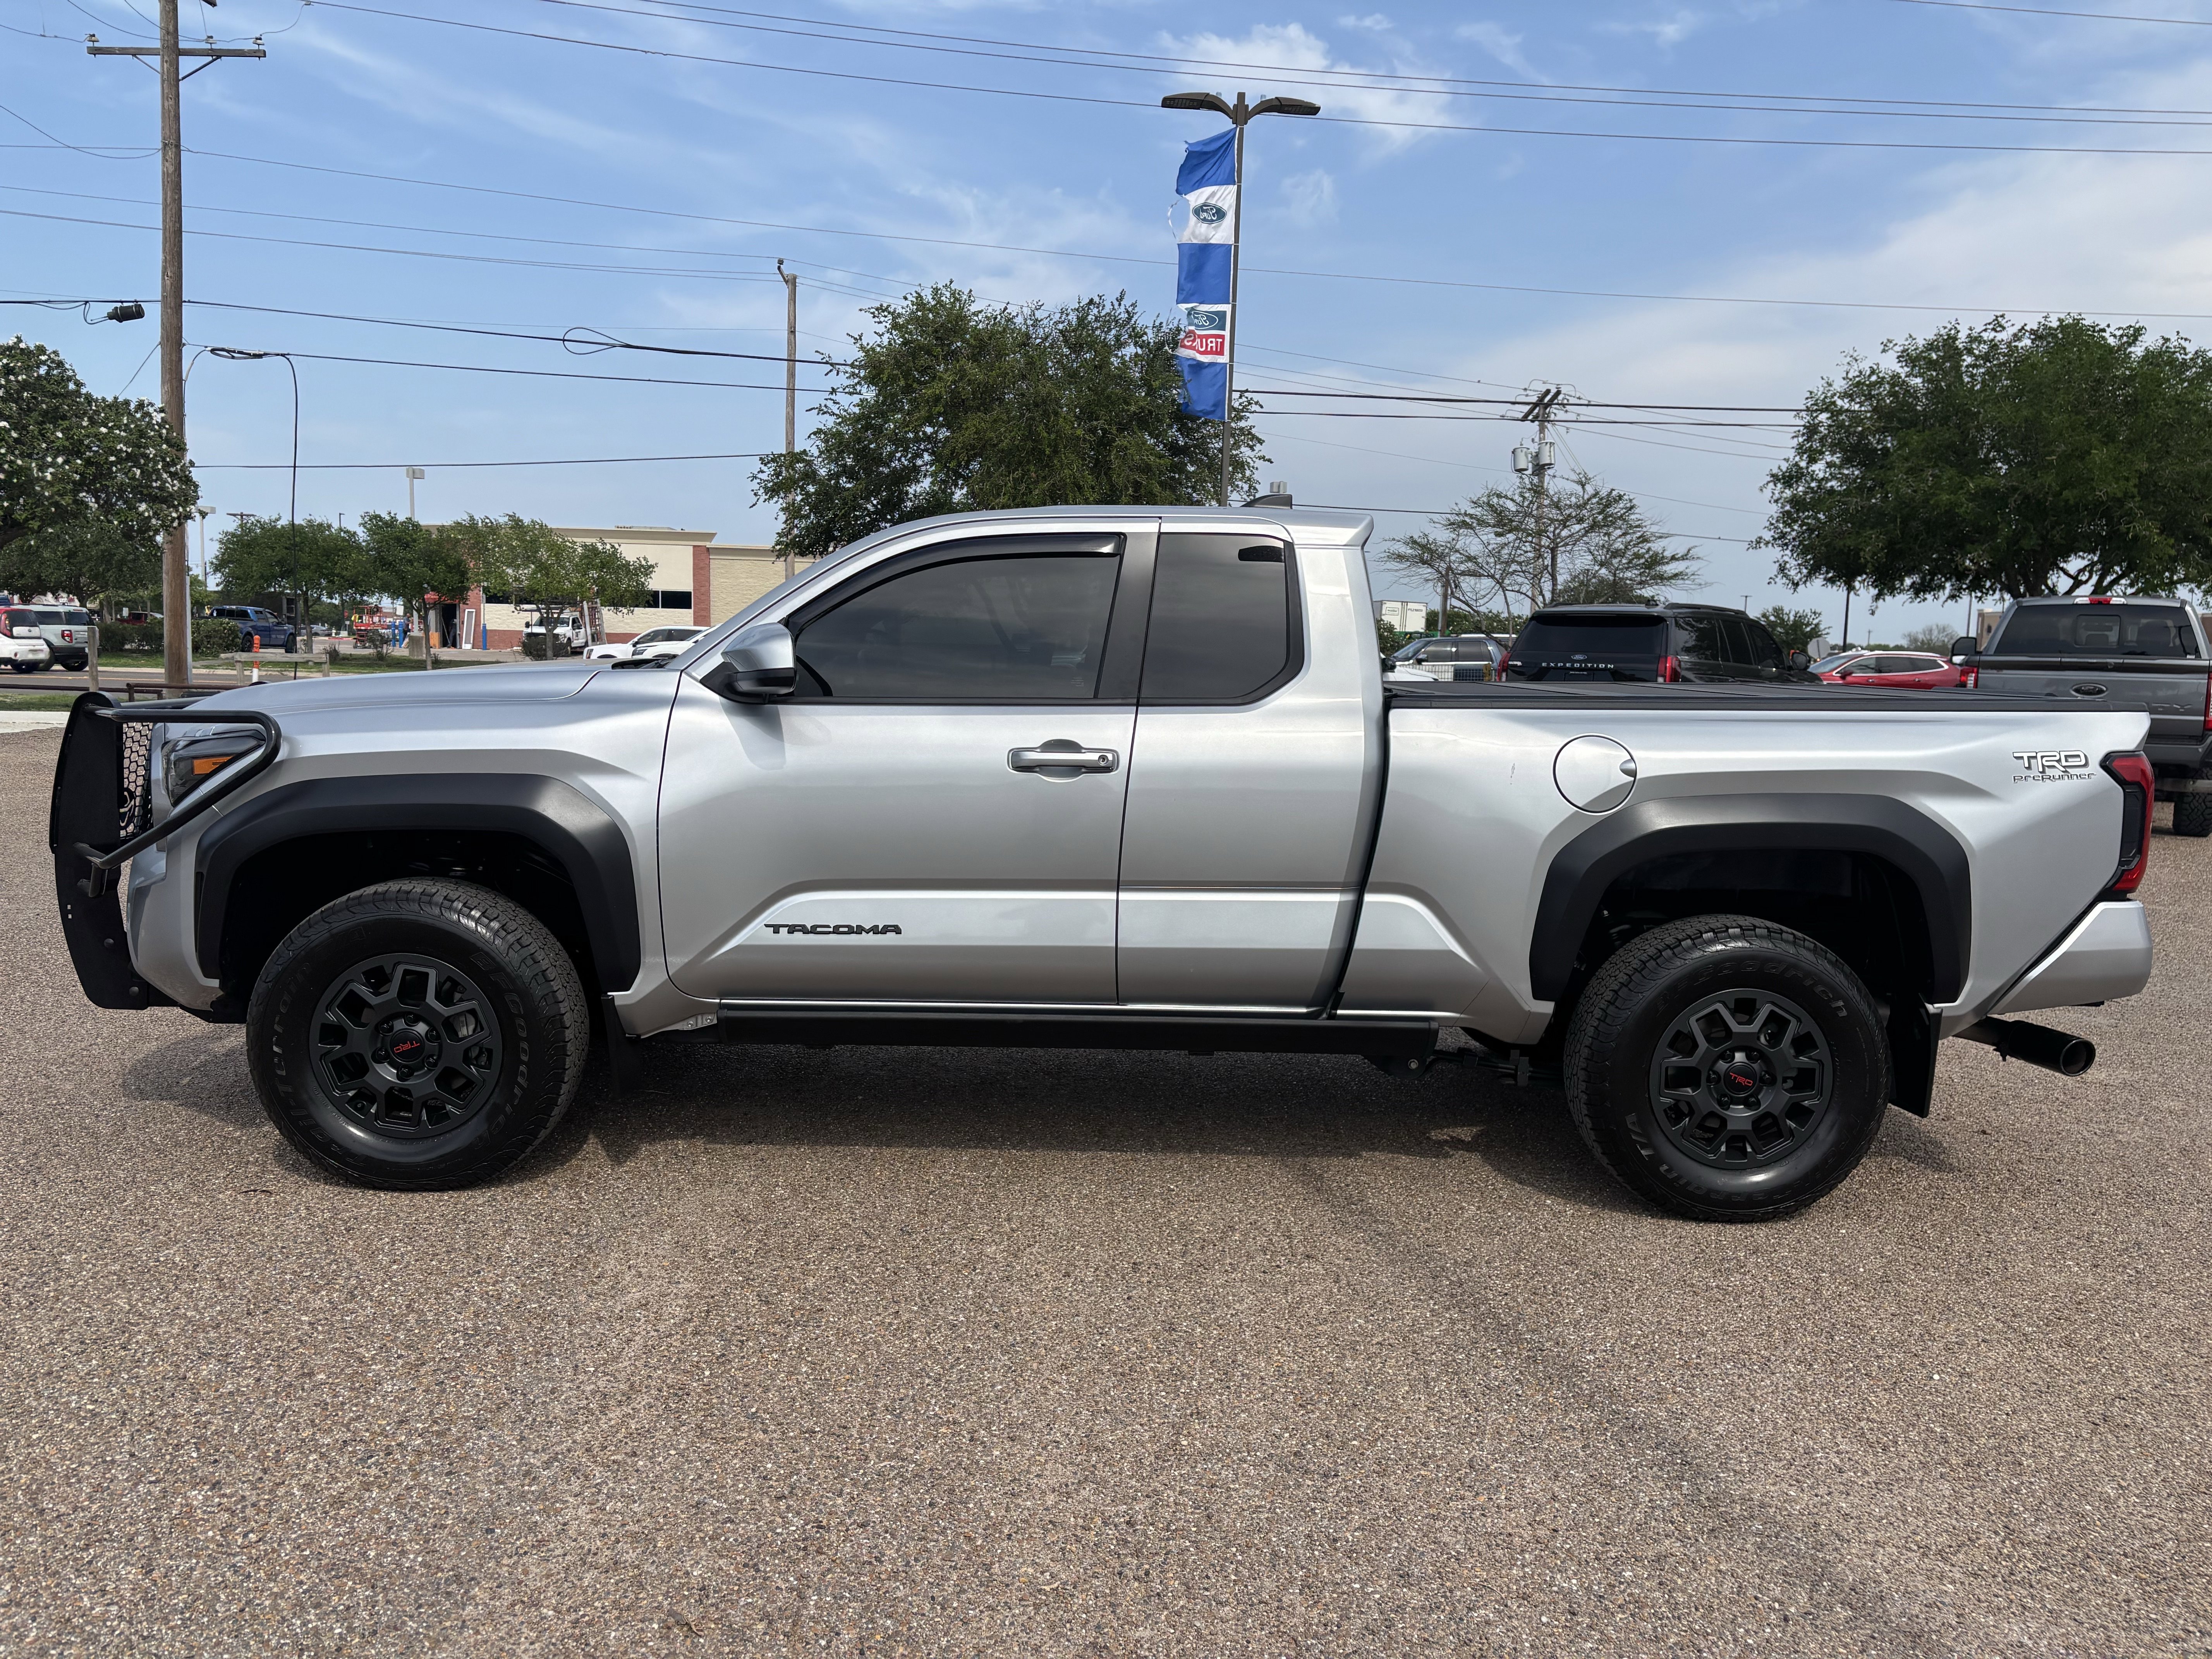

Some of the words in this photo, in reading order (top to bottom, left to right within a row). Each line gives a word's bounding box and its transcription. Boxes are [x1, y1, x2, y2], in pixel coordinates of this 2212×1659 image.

[2013, 750, 2089, 773] TRD
[2013, 773, 2096, 783] PreRunner
[764, 924, 902, 934] TACOMA
[394, 1041, 420, 1053] TRD
[1729, 1072, 1753, 1086] TRD
